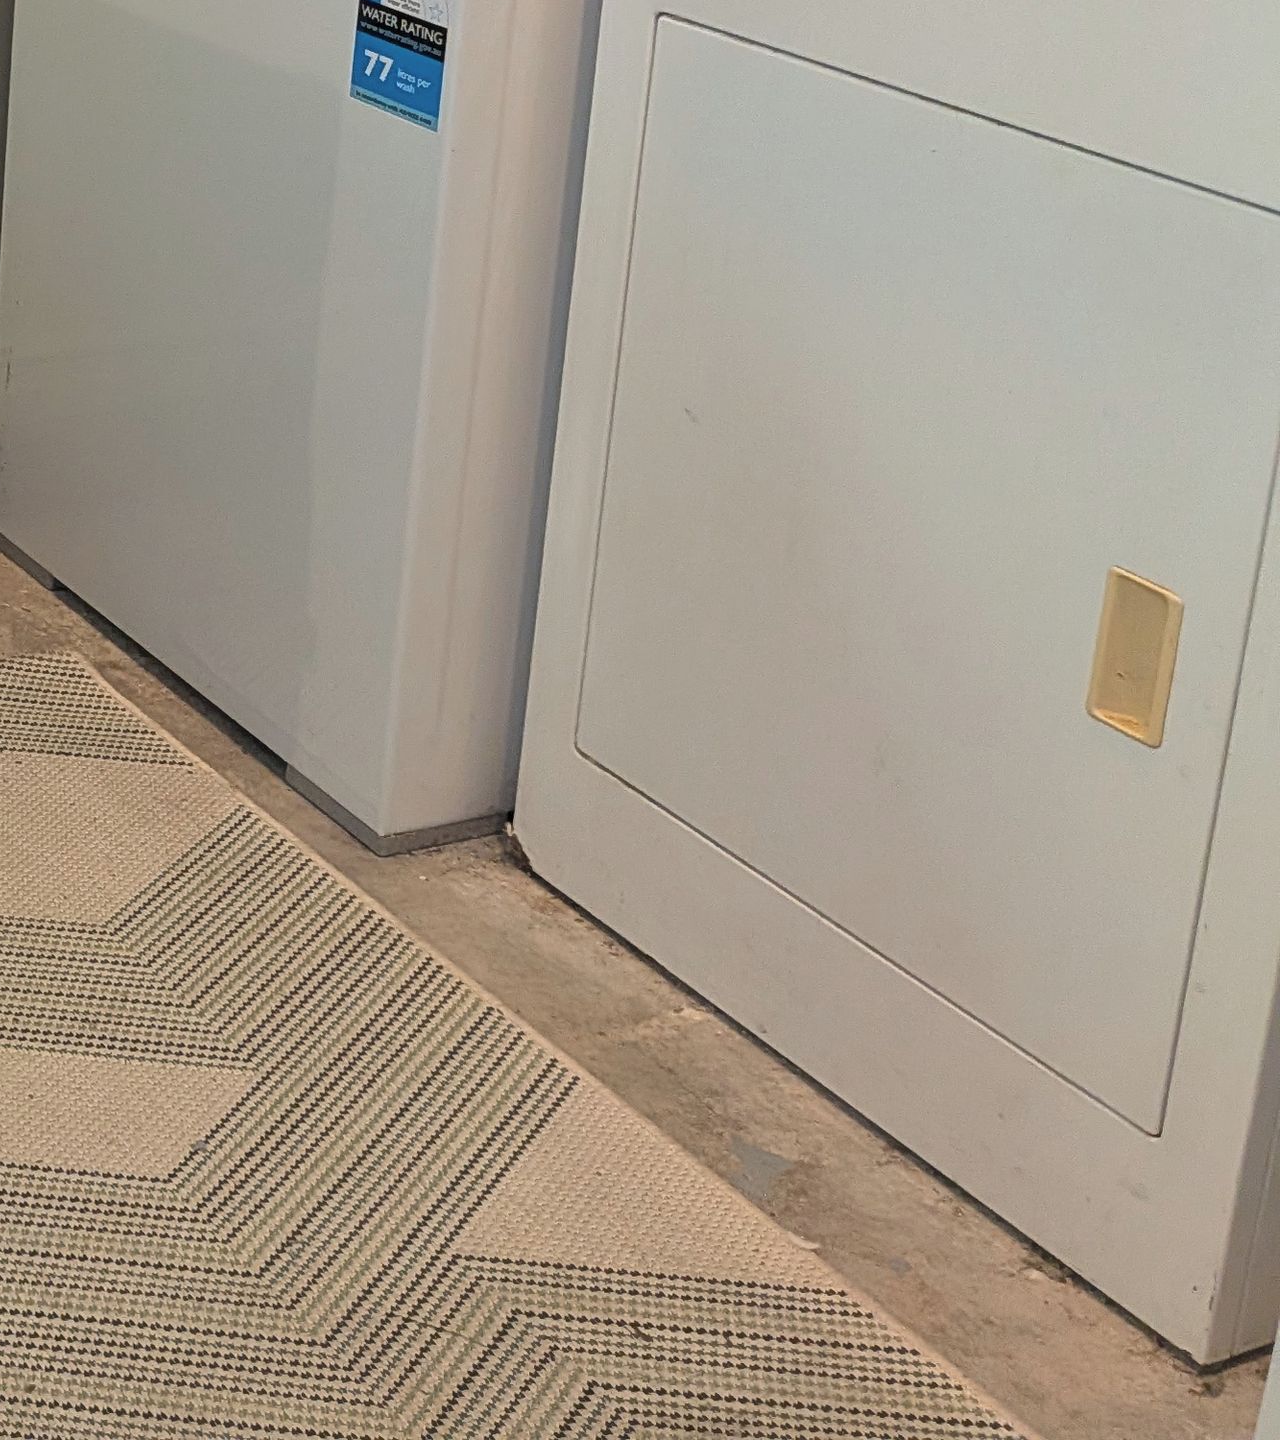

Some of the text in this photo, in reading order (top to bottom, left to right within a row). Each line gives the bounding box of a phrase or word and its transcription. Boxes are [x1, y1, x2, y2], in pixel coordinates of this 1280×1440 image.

[361, 4, 444, 46] WATER RATING
[364, 48, 394, 82] 77
